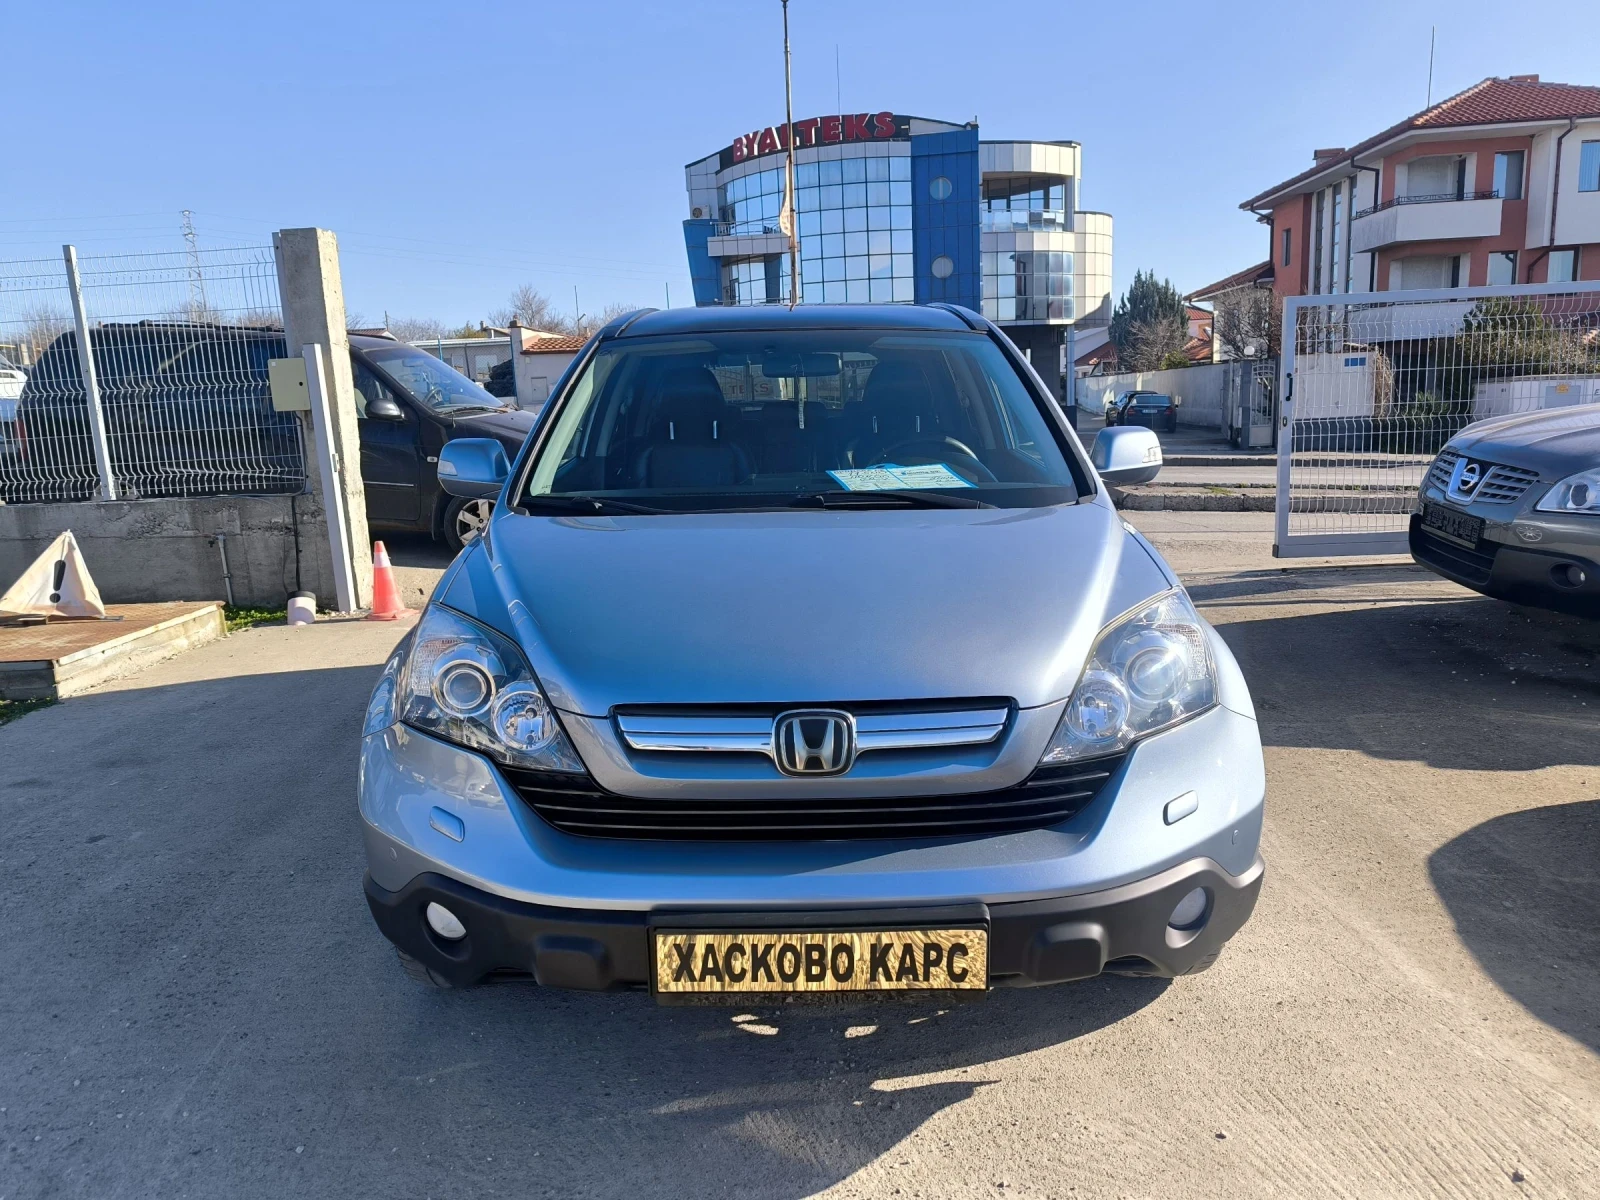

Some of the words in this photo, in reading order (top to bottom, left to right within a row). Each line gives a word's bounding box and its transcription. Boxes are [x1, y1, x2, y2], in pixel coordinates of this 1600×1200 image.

[733, 111, 896, 163] BYALTEKS
[673, 943, 855, 983] ХАСКОВО
[869, 942, 969, 984] КАРС
